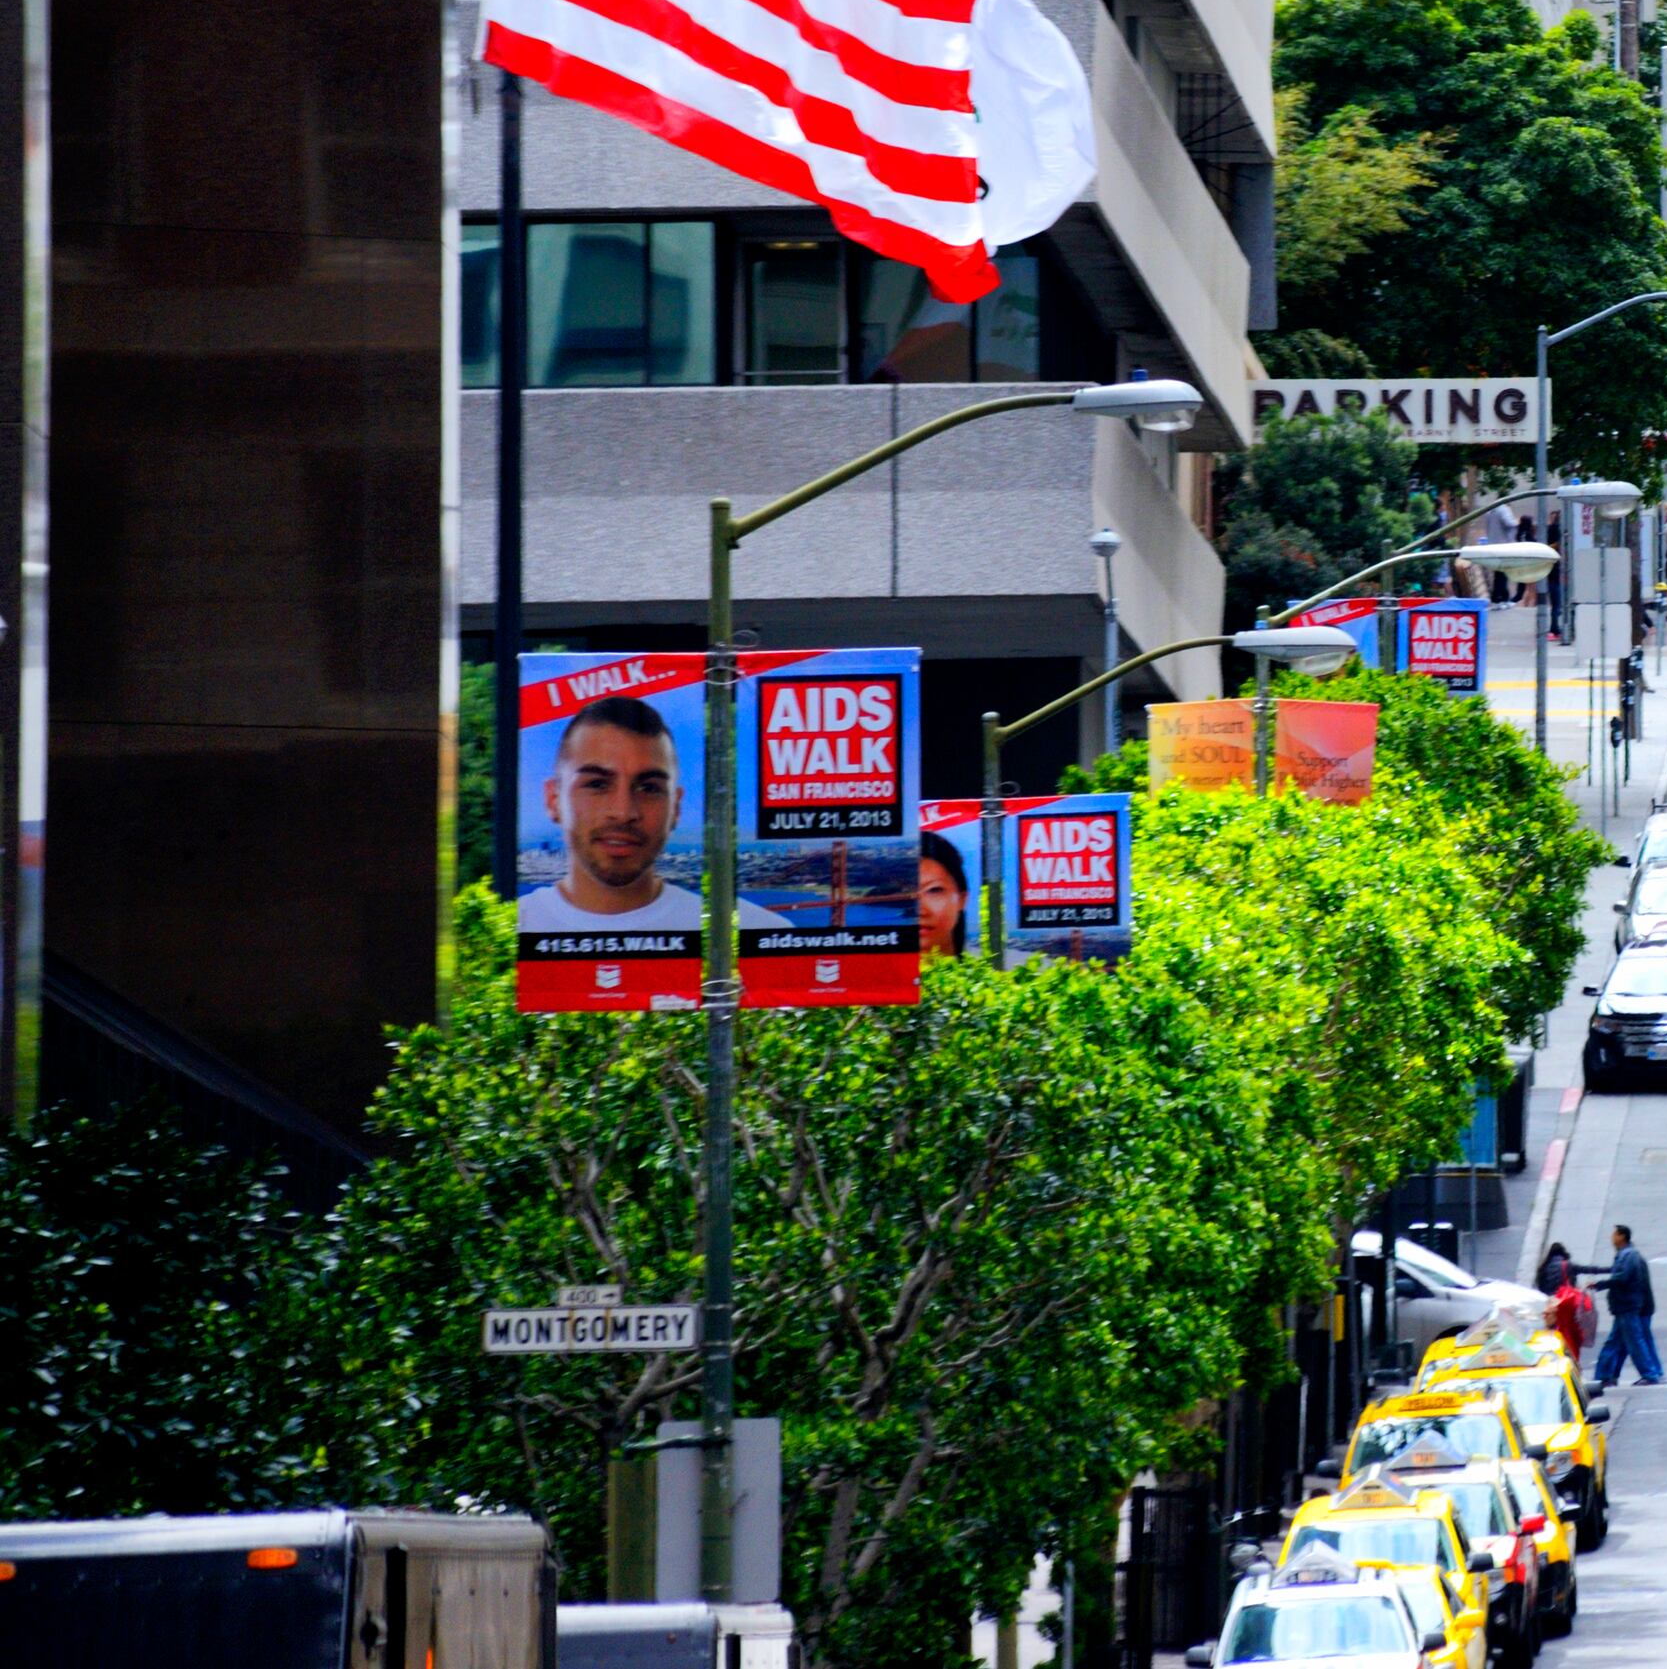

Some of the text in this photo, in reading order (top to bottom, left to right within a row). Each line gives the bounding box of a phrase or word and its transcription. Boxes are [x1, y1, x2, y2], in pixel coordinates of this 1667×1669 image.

[1253, 388, 1527, 424] PARKING
[1474, 429, 1527, 437] STREET
[1412, 616, 1475, 640] AIDS
[1412, 641, 1474, 660] WALK
[547, 660, 676, 707] I WALK...
[768, 685, 893, 732] AIDS
[1199, 717, 1244, 734] heart
[768, 738, 893, 775] WALK
[1192, 746, 1245, 763] SOUL
[1297, 752, 1348, 768] Support
[767, 780, 893, 801] SAN FRANCISCO
[1322, 773, 1366, 789] Higher
[770, 810, 892, 831] JULY 21, 2013
[1024, 819, 1113, 853] AIDS
[1024, 855, 1113, 883] WALK
[1026, 909, 1059, 921] JULY
[1082, 907, 1113, 920] 2013
[535, 937, 685, 953] 415.615.WALK
[758, 932, 899, 949] aidswalk.net
[490, 1314, 690, 1344] MONTGOMERY
